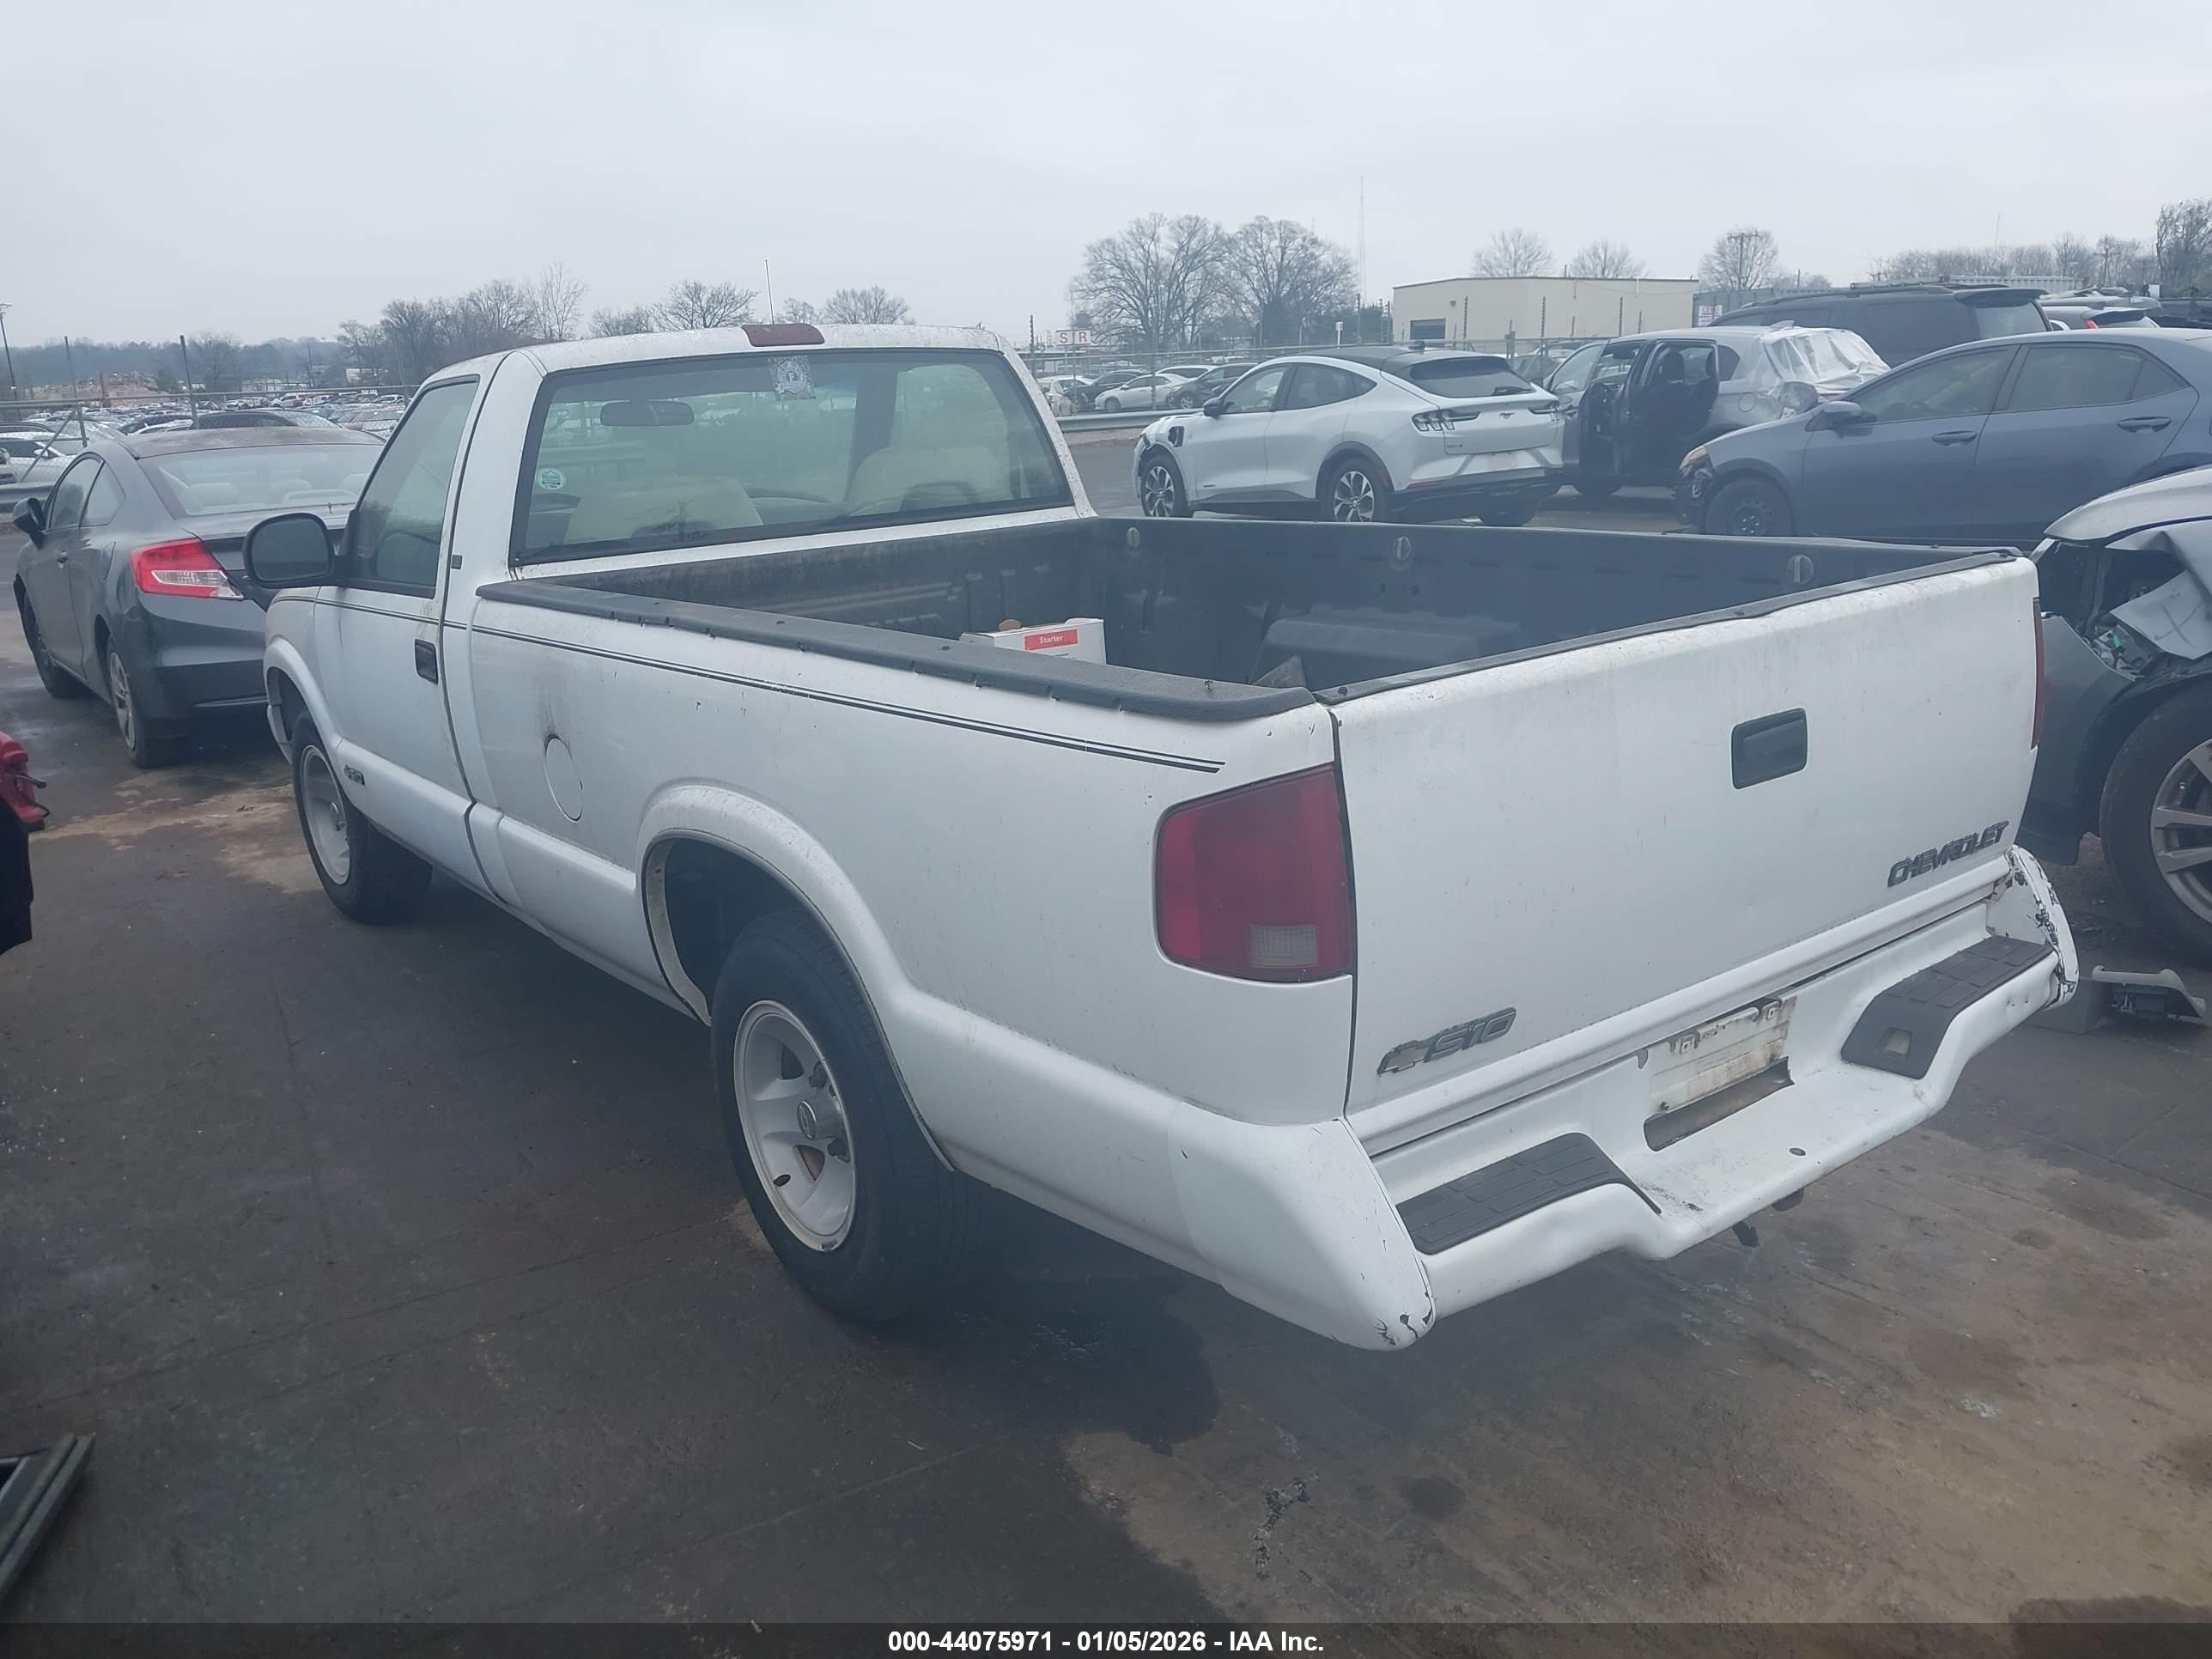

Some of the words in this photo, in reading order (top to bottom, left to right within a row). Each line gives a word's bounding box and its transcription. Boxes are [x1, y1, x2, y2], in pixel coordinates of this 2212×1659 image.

[1039, 635, 1064, 644] Starter
[1887, 820, 2009, 887] CHEVROLET
[1429, 1008, 1516, 1058] S10
